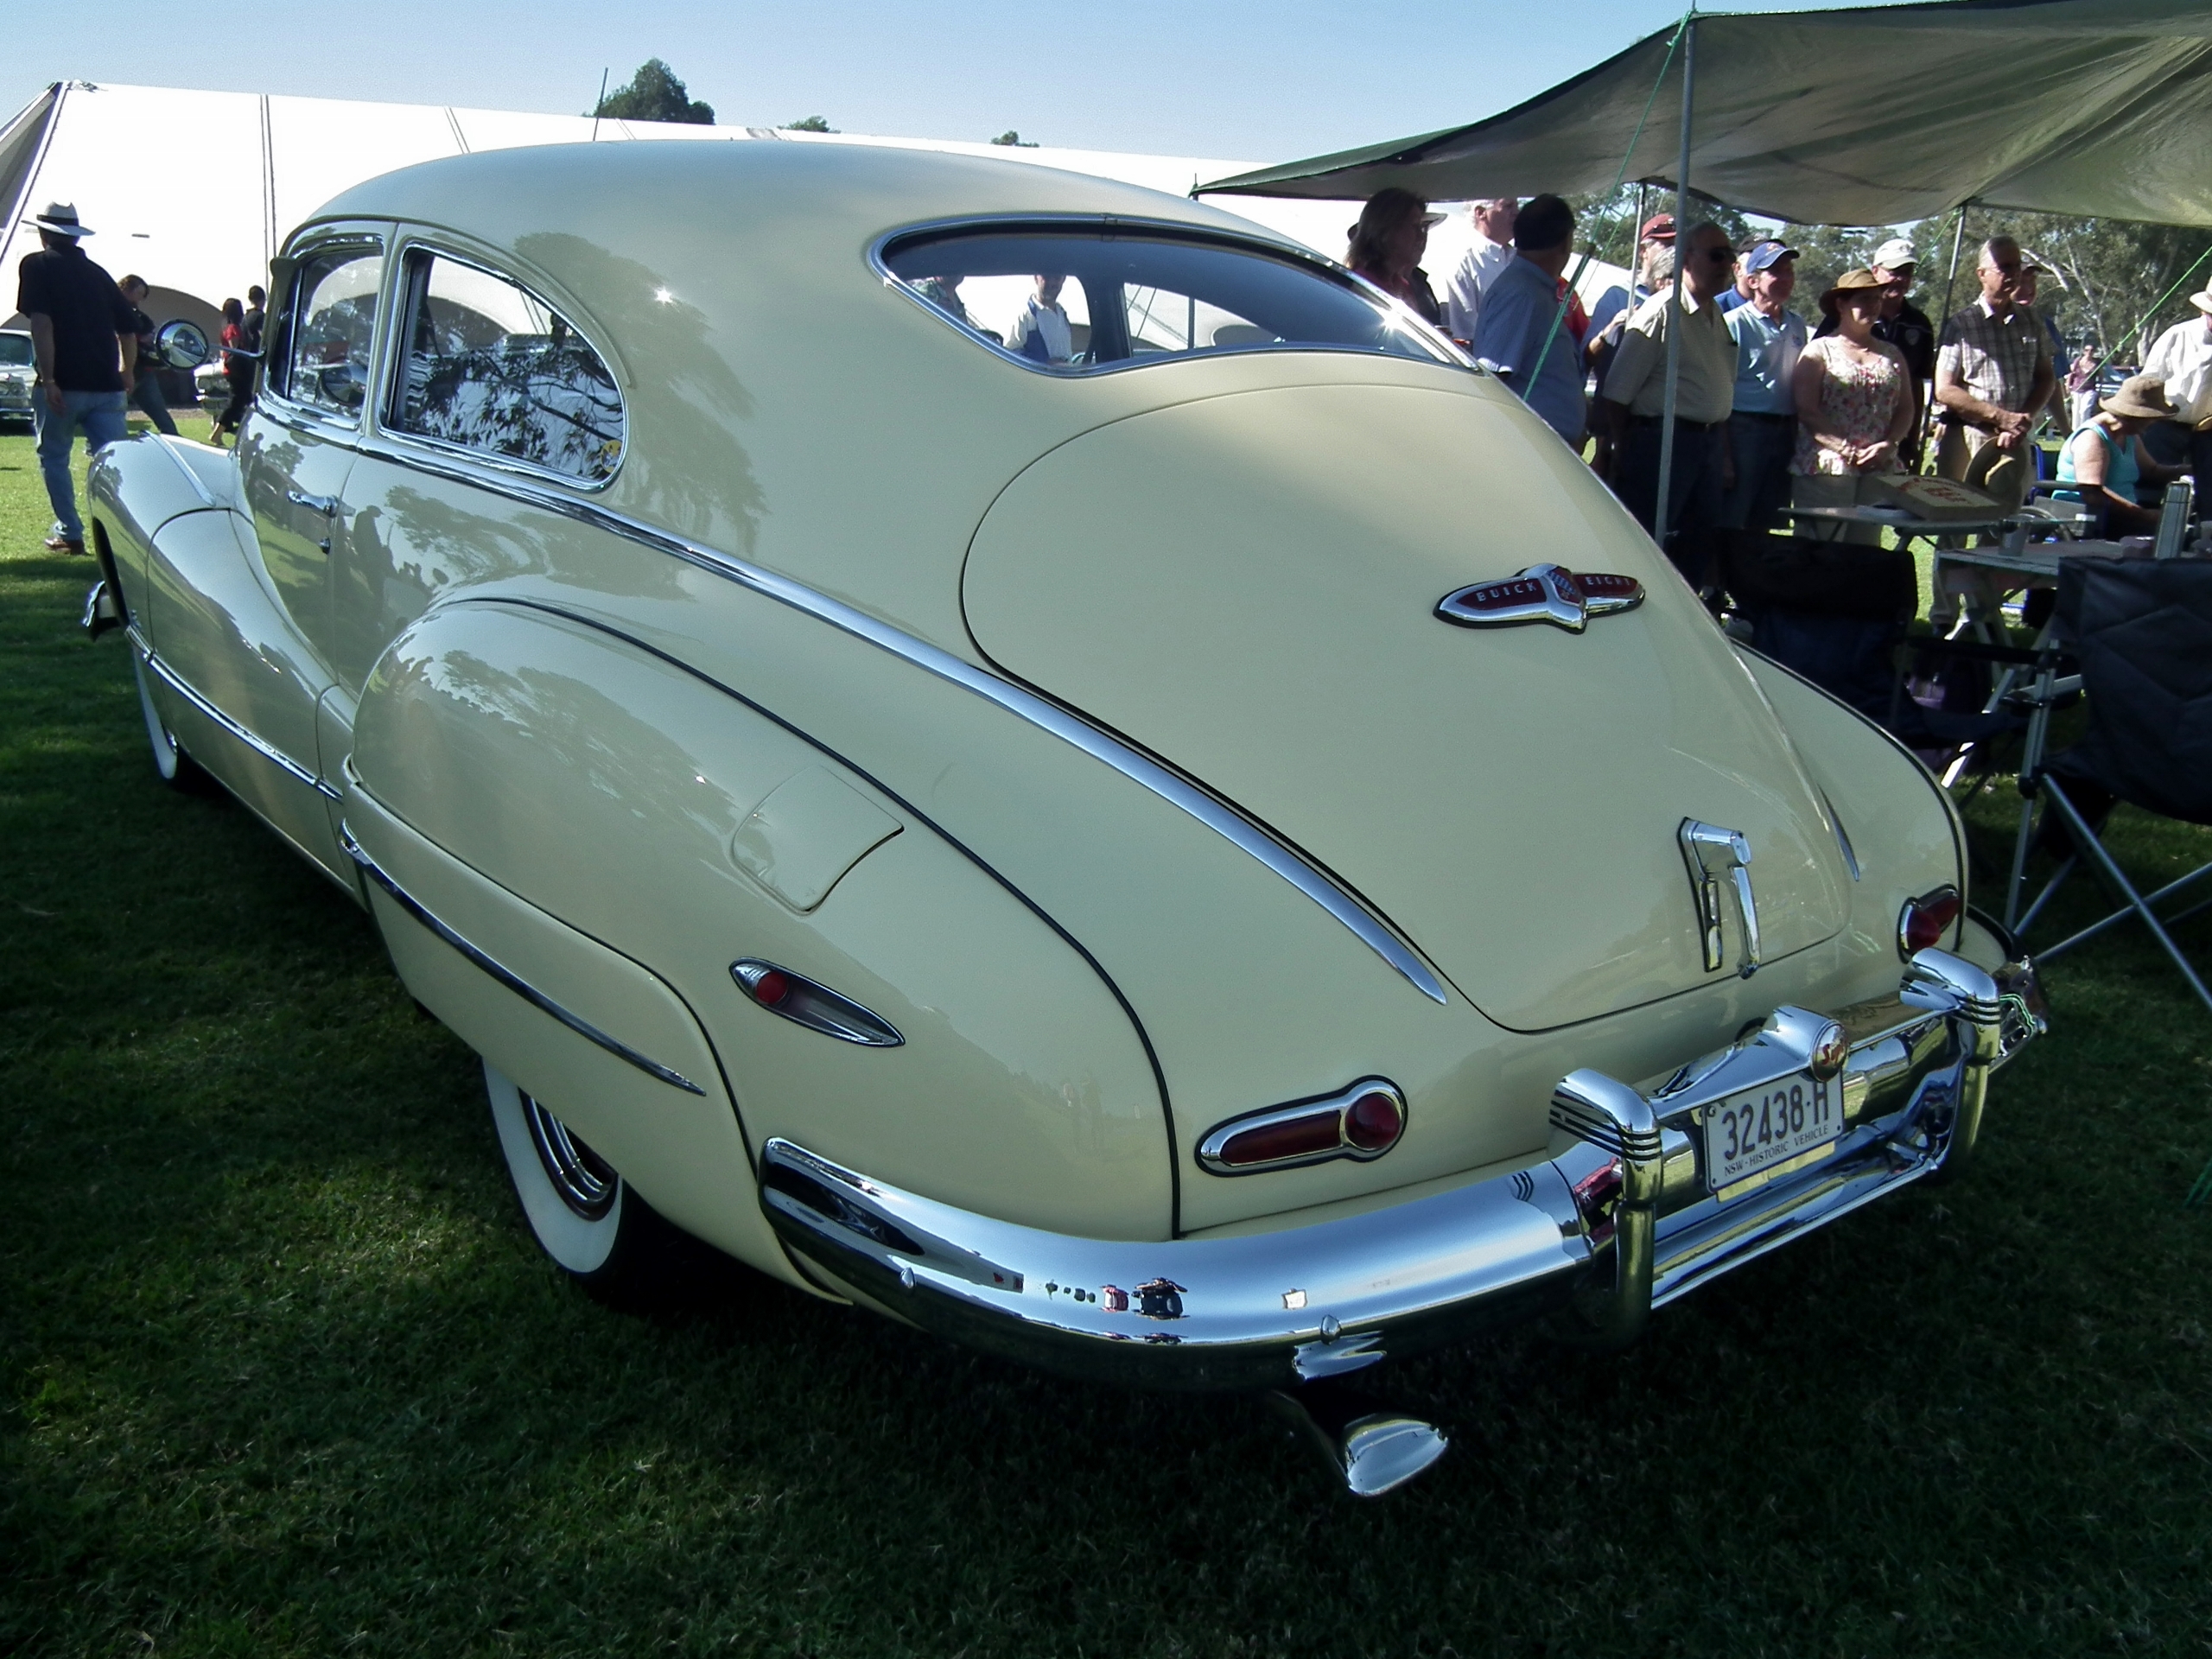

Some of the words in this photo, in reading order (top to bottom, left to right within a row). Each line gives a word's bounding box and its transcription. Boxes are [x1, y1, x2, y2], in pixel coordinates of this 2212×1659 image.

[1476, 582, 1537, 602] BUICK
[1585, 575, 1631, 587] EIGHT
[1794, 1124, 1828, 1147] VEHICLE
